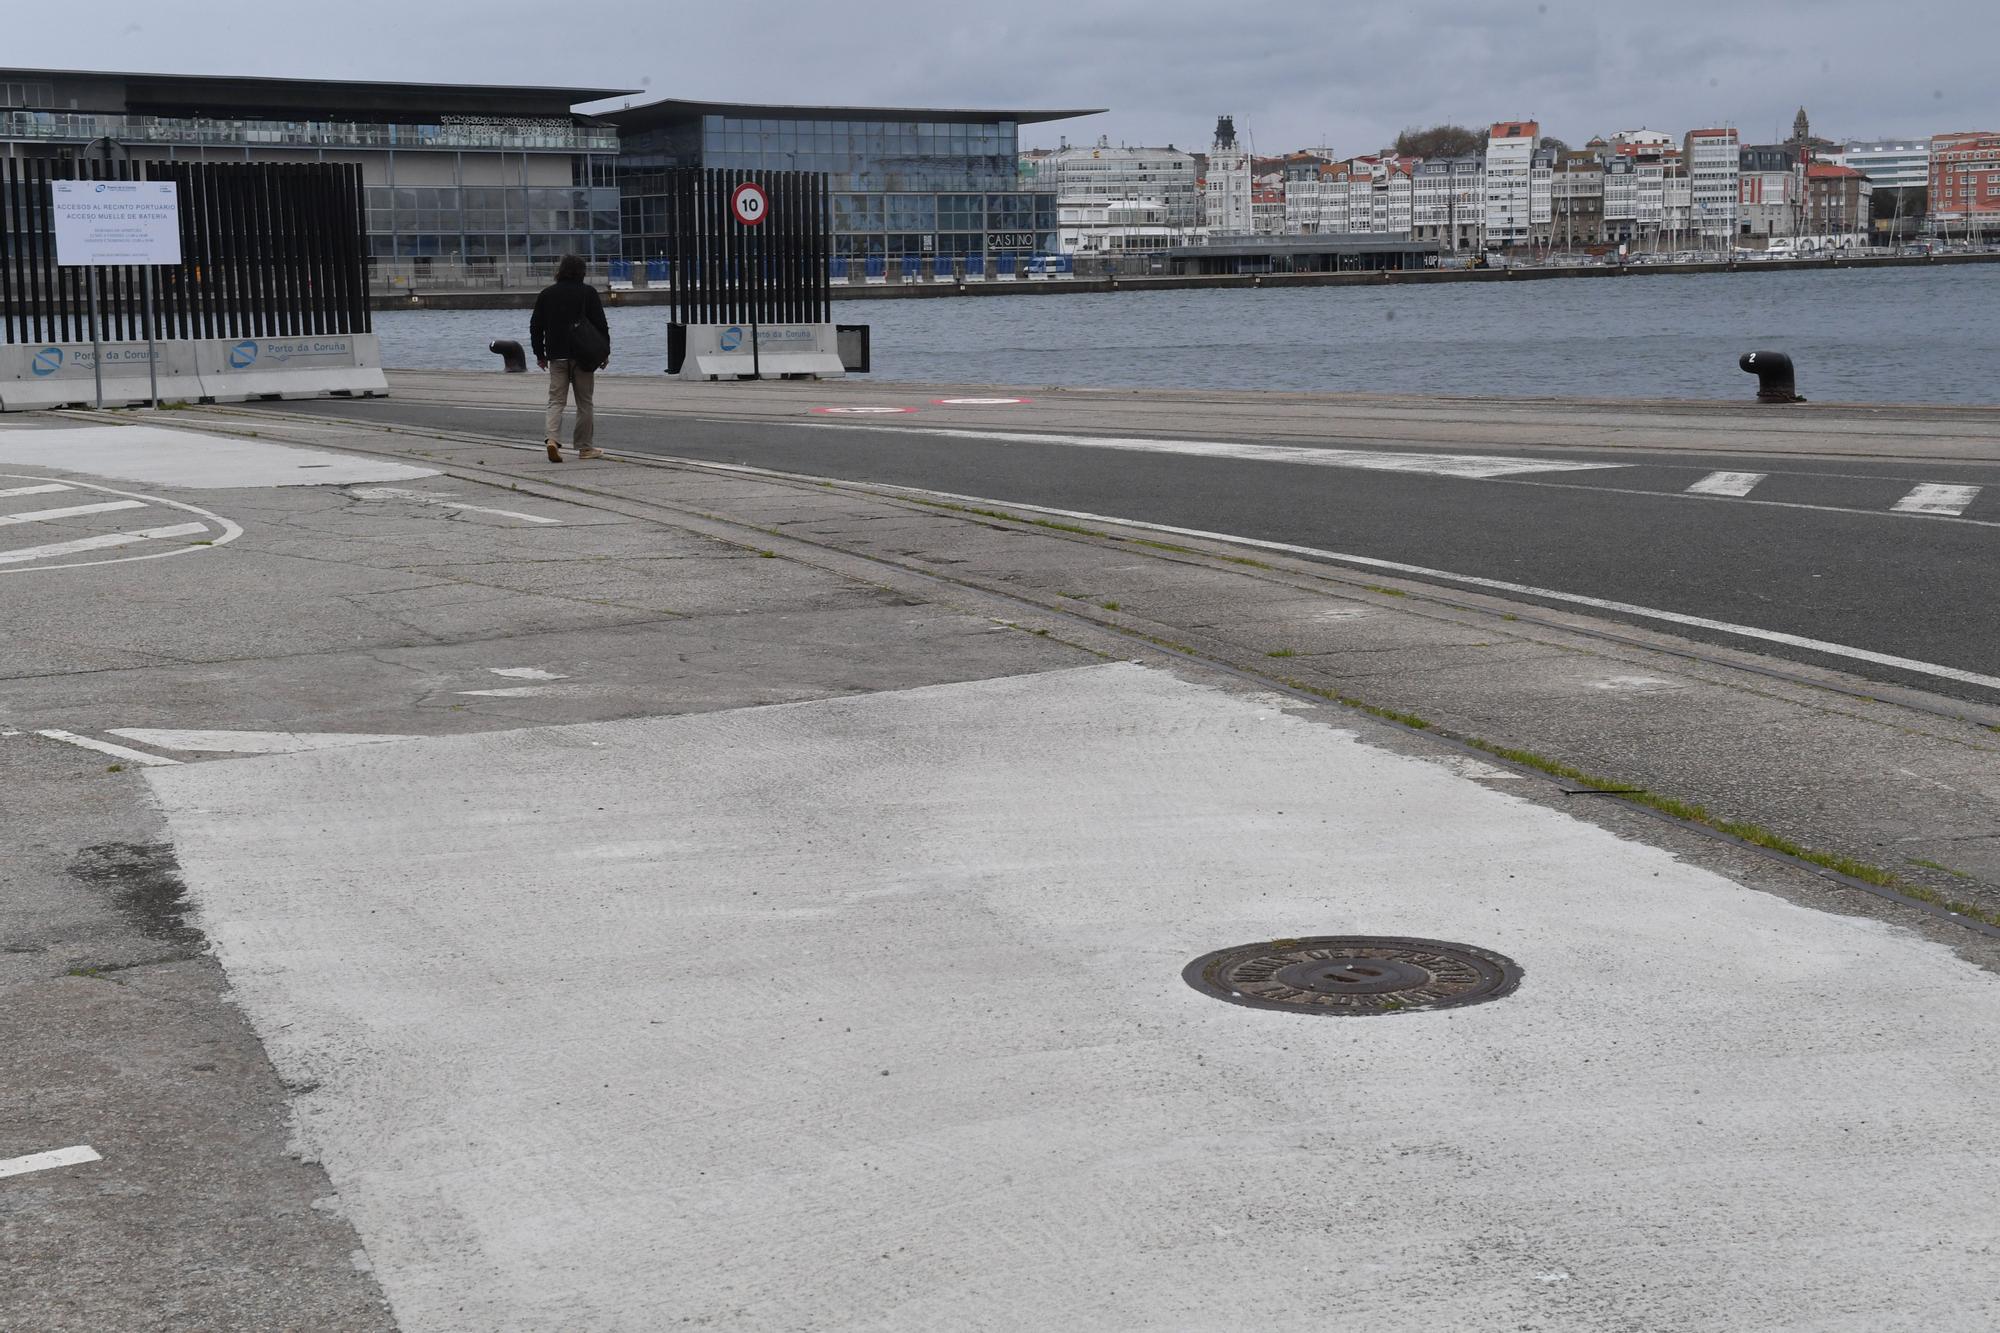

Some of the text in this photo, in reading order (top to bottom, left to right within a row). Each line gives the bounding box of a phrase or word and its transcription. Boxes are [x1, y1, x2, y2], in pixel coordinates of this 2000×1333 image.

[742, 199, 758, 212] 10
[987, 234, 1033, 246] CASINO
[773, 330, 783, 338] da
[267, 342, 346, 353] Porto da Coruña
[74, 351, 101, 360] Port
[106, 351, 119, 360] da
[1749, 353, 1756, 363] 2
[1305, 948, 1370, 960] DEL
